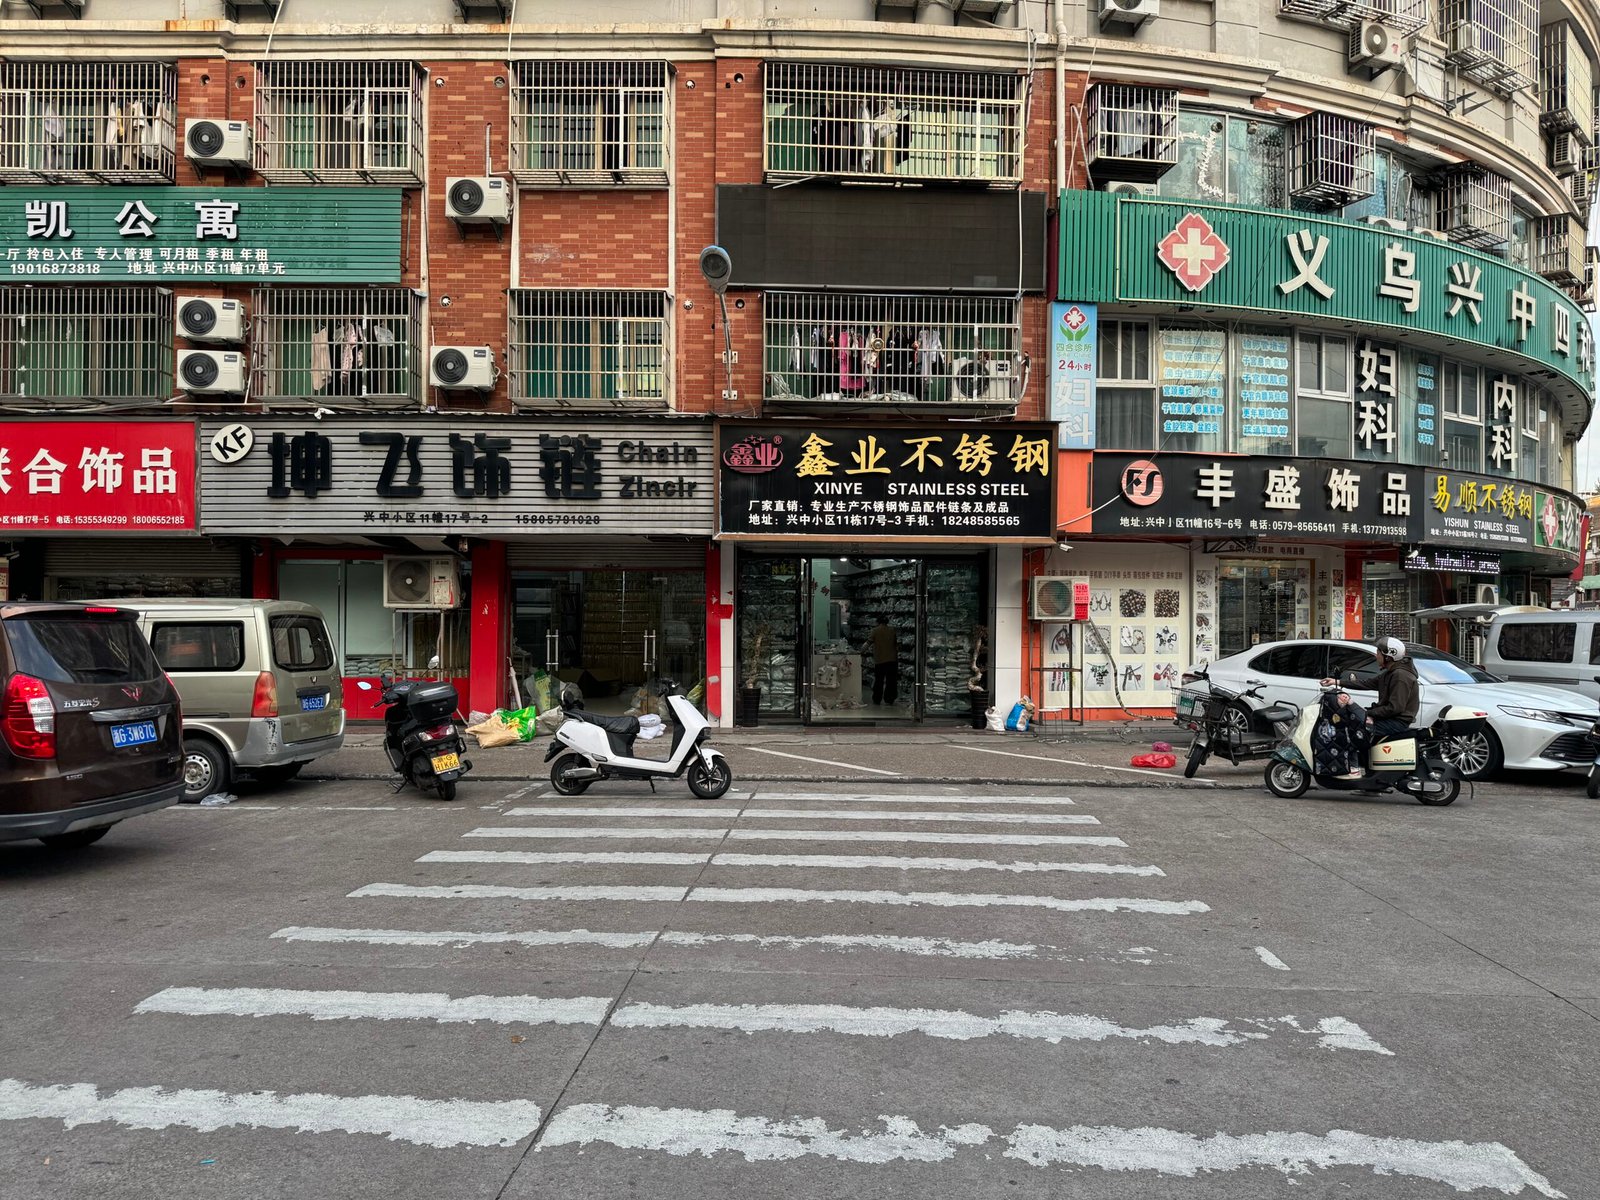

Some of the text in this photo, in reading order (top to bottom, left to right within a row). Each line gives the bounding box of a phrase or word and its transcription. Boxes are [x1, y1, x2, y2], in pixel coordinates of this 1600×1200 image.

[25, 199, 240, 240] 凯公寓
[26, 247, 84, 260] 拎包入住
[94, 247, 153, 260] 专人管理
[159, 247, 199, 260] 可月租
[206, 248, 234, 260] 季租
[240, 248, 269, 261] 年租
[10, 261, 286, 275] 19016873818 地址 兴中小区11幢17单元
[1058, 359, 1092, 371] 24小时
[1358, 339, 1396, 453] 妇科
[1055, 375, 1093, 446] 妇科
[1492, 374, 1518, 472] 内科
[213, 426, 247, 460] KF
[617, 440, 698, 463] Chain
[794, 431, 1050, 478] 鑫业不锈钢
[618, 474, 698, 498] Zincir
[814, 482, 1029, 496] XINYE STAINLESS STEEL
[1197, 462, 1411, 516] 丰盛饰品
[1432, 475, 1532, 520] 易顺不锈钢
[132, 515, 185, 524] 18006552185
[515, 513, 601, 525] 15805791028
[1444, 517, 1521, 535] YISHUN STAINLESS STEEL
